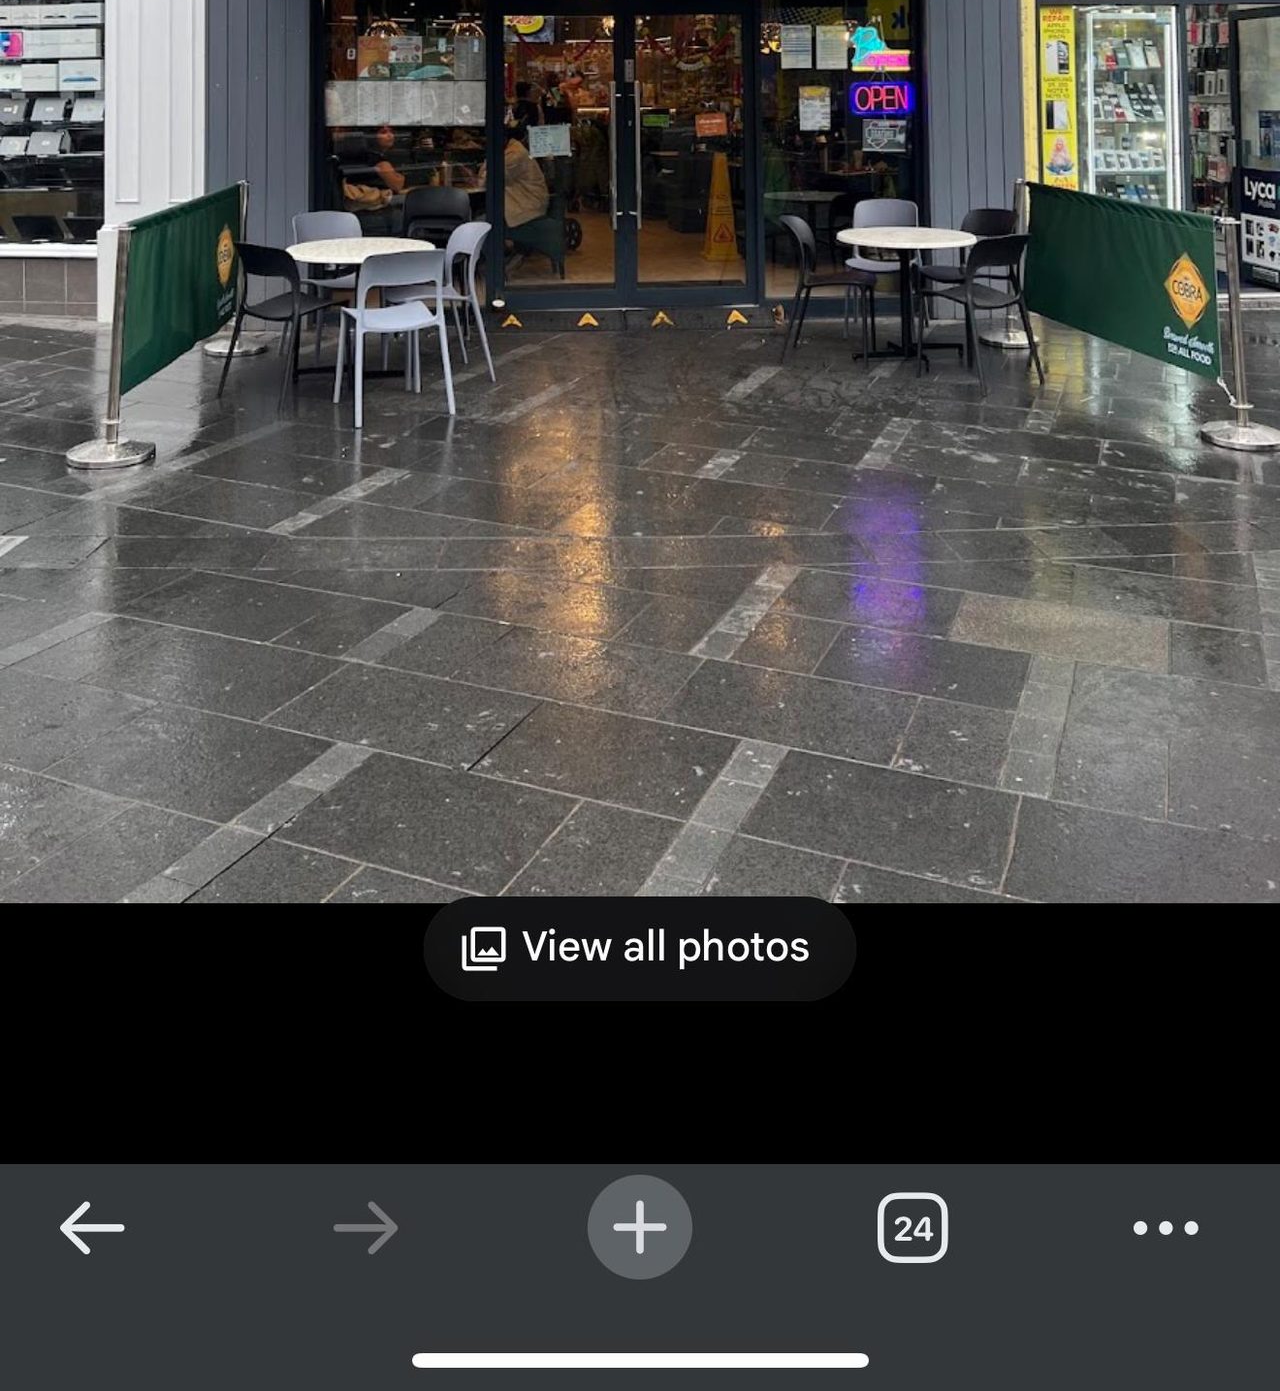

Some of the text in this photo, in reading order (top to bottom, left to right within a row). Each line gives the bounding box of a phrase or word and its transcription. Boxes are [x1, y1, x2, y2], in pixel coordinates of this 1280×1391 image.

[854, 85, 909, 111] OPEN
[1243, 176, 1276, 200] Lyca
[1172, 279, 1202, 303] COBRA
[1190, 350, 1212, 366] FOOD
